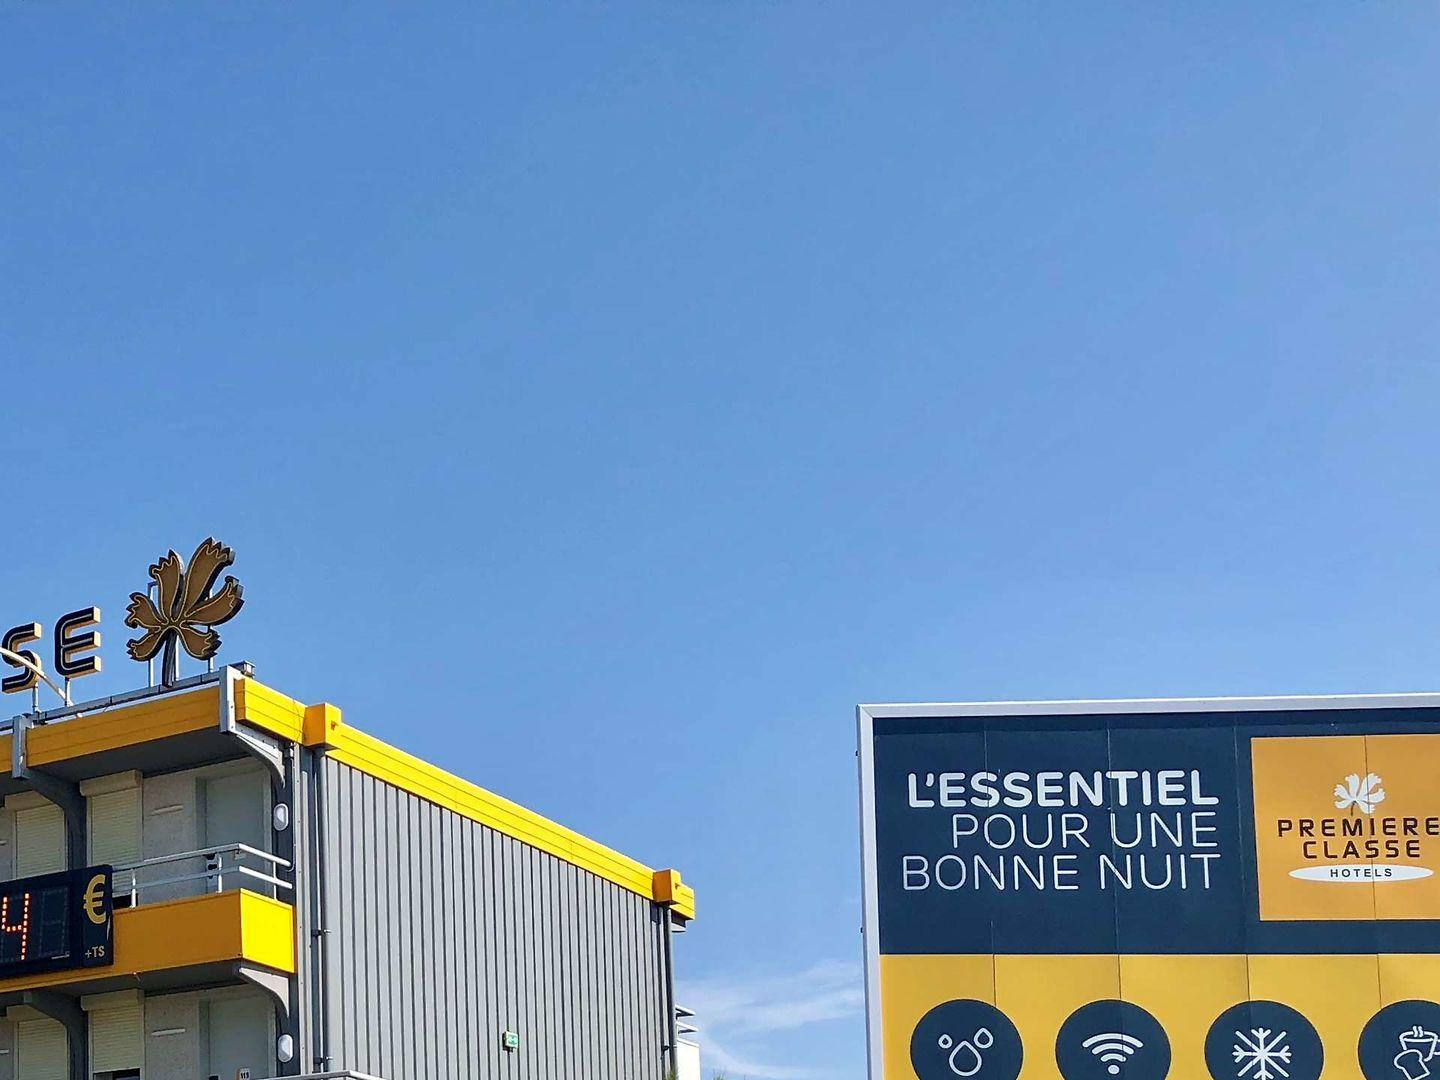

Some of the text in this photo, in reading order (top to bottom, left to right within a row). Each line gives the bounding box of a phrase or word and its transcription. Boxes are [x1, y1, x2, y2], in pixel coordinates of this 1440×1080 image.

[908, 770, 1219, 808] L'ESSENTIEL
[952, 811, 1218, 849] POUR UNE
[1277, 817, 1440, 837] PREMIERE
[1302, 840, 1421, 859] CLASSE
[902, 853, 1221, 891] BONNE NUIT
[1330, 868, 1392, 878] HOTELS
